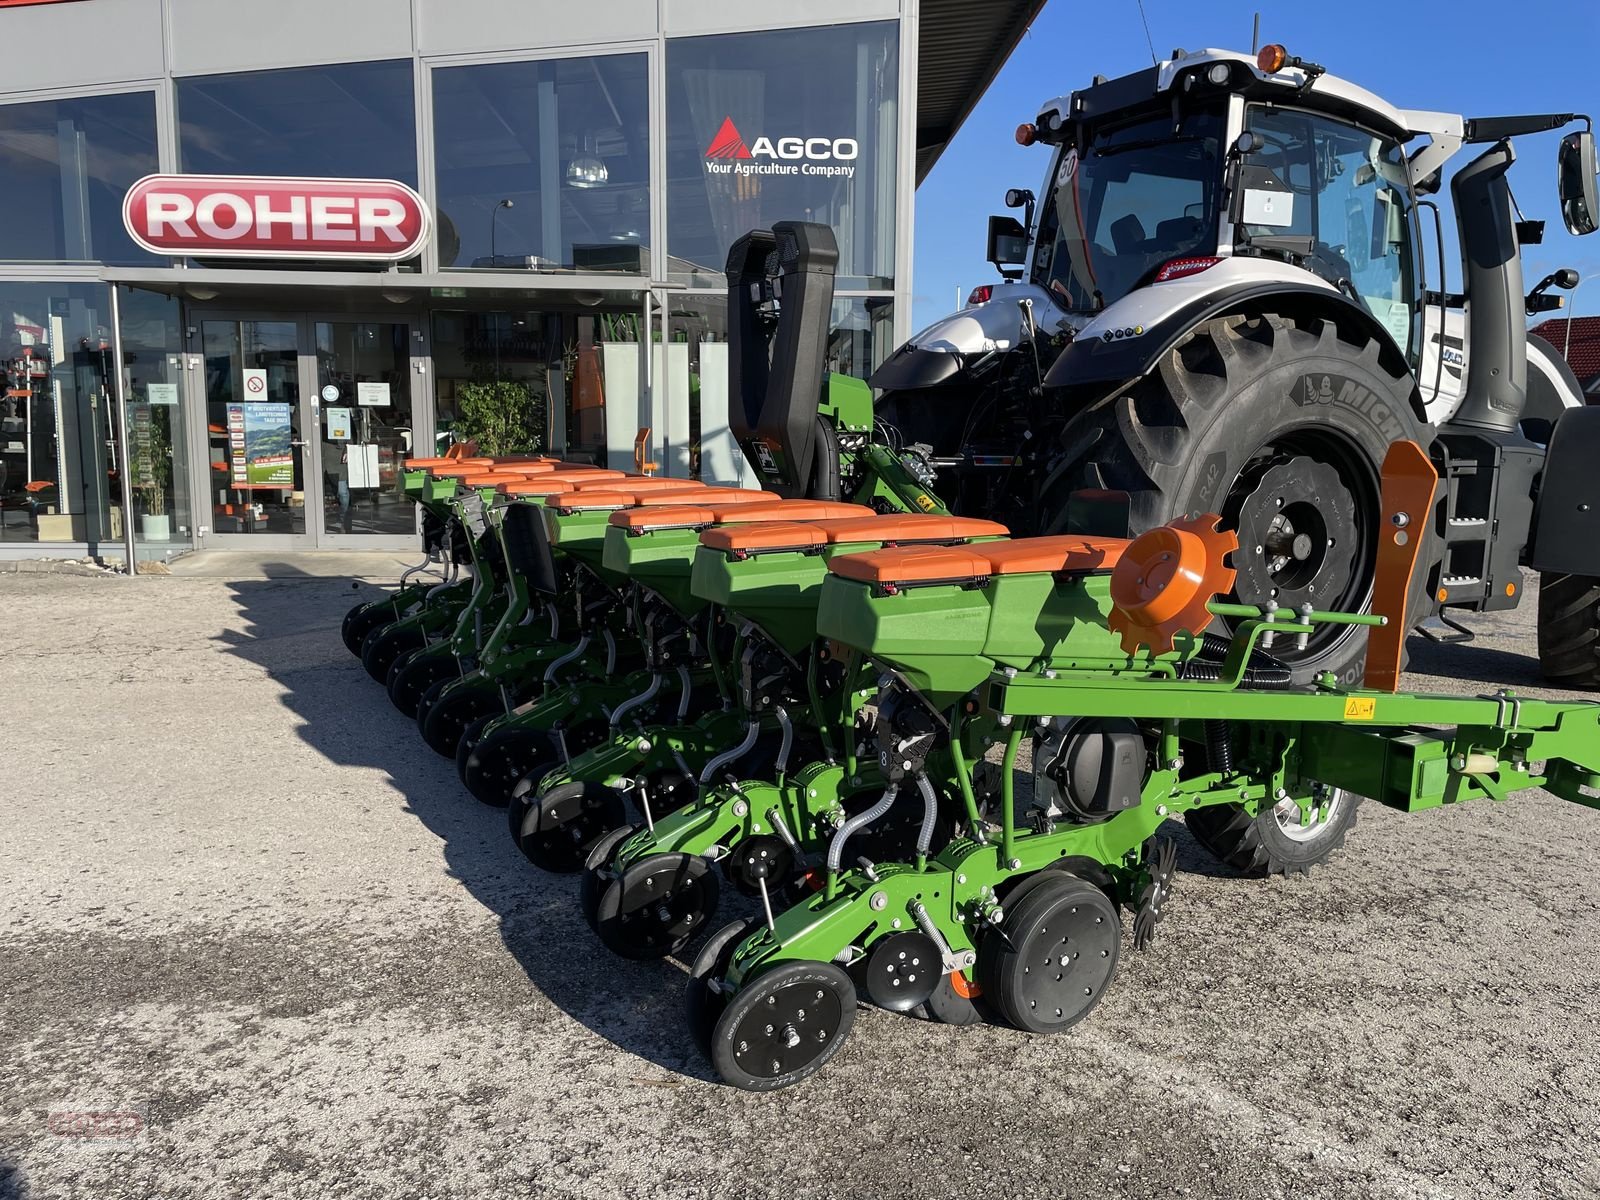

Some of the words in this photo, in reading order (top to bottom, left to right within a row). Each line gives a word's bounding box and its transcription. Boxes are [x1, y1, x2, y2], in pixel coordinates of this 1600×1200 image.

[750, 136, 859, 160] AGCO
[706, 161, 732, 174] Your
[734, 162, 799, 177] Agriculture
[801, 163, 855, 178] Company
[1060, 154, 1076, 179] 50
[145, 192, 408, 243] ROHER
[881, 750, 887, 767] 8
